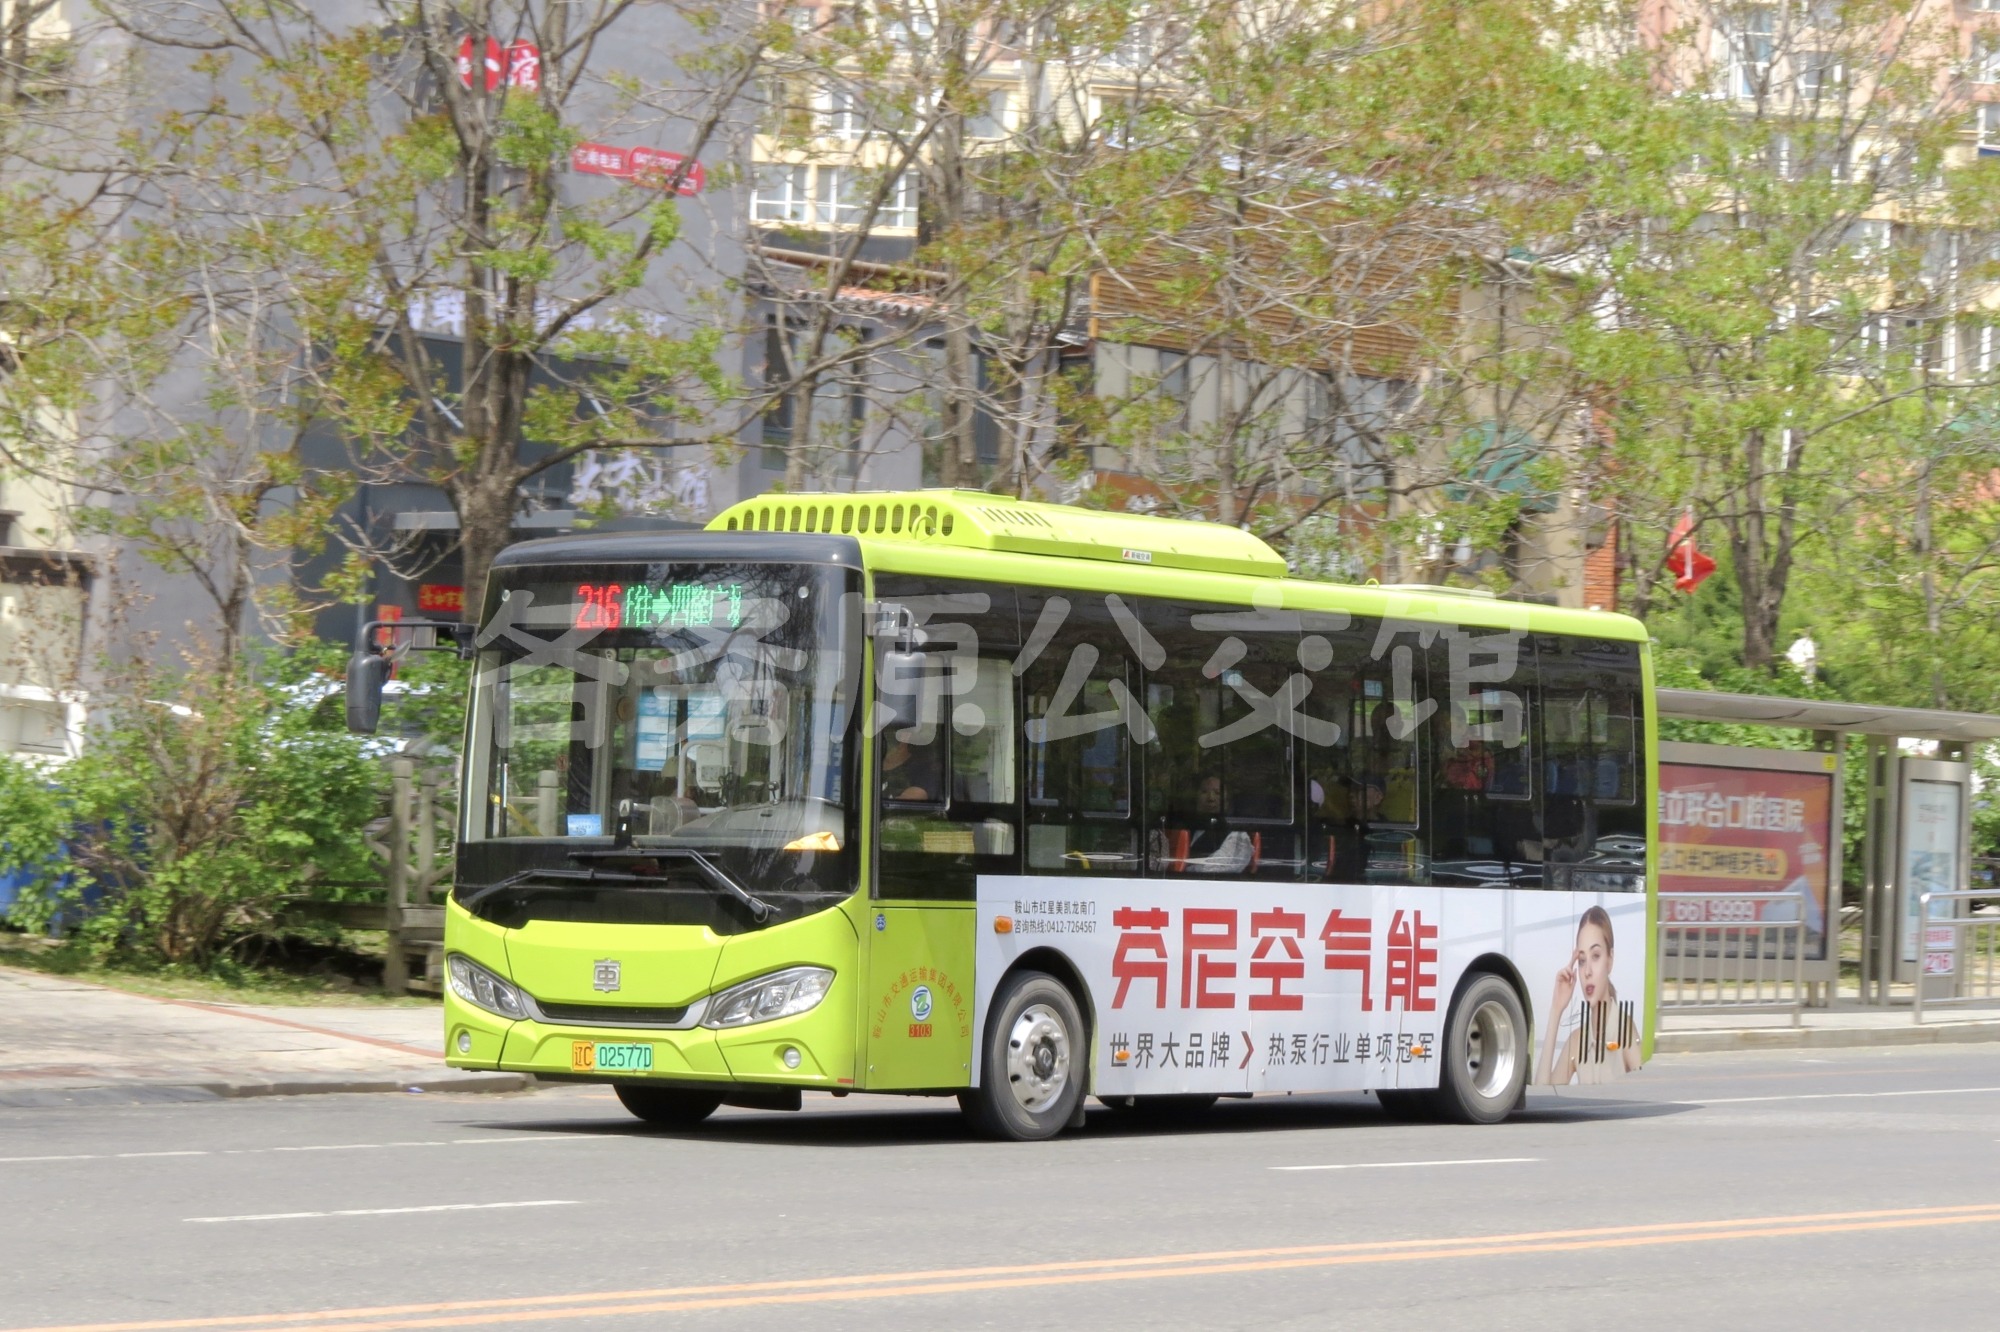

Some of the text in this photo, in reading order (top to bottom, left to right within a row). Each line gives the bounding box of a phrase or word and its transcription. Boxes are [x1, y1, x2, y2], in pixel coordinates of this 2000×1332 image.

[576, 583, 622, 630] 216
[1014, 900, 1096, 915] 鞍山市红星美凯龙南门
[1111, 906, 1438, 1012] 芬尼空气能
[873, 966, 969, 1039] 鞍山市交通运输集团有限公司
[909, 1024, 932, 1037] 3103
[1109, 1031, 1435, 1069] 世界大品牌 热泵行业单项冠军
